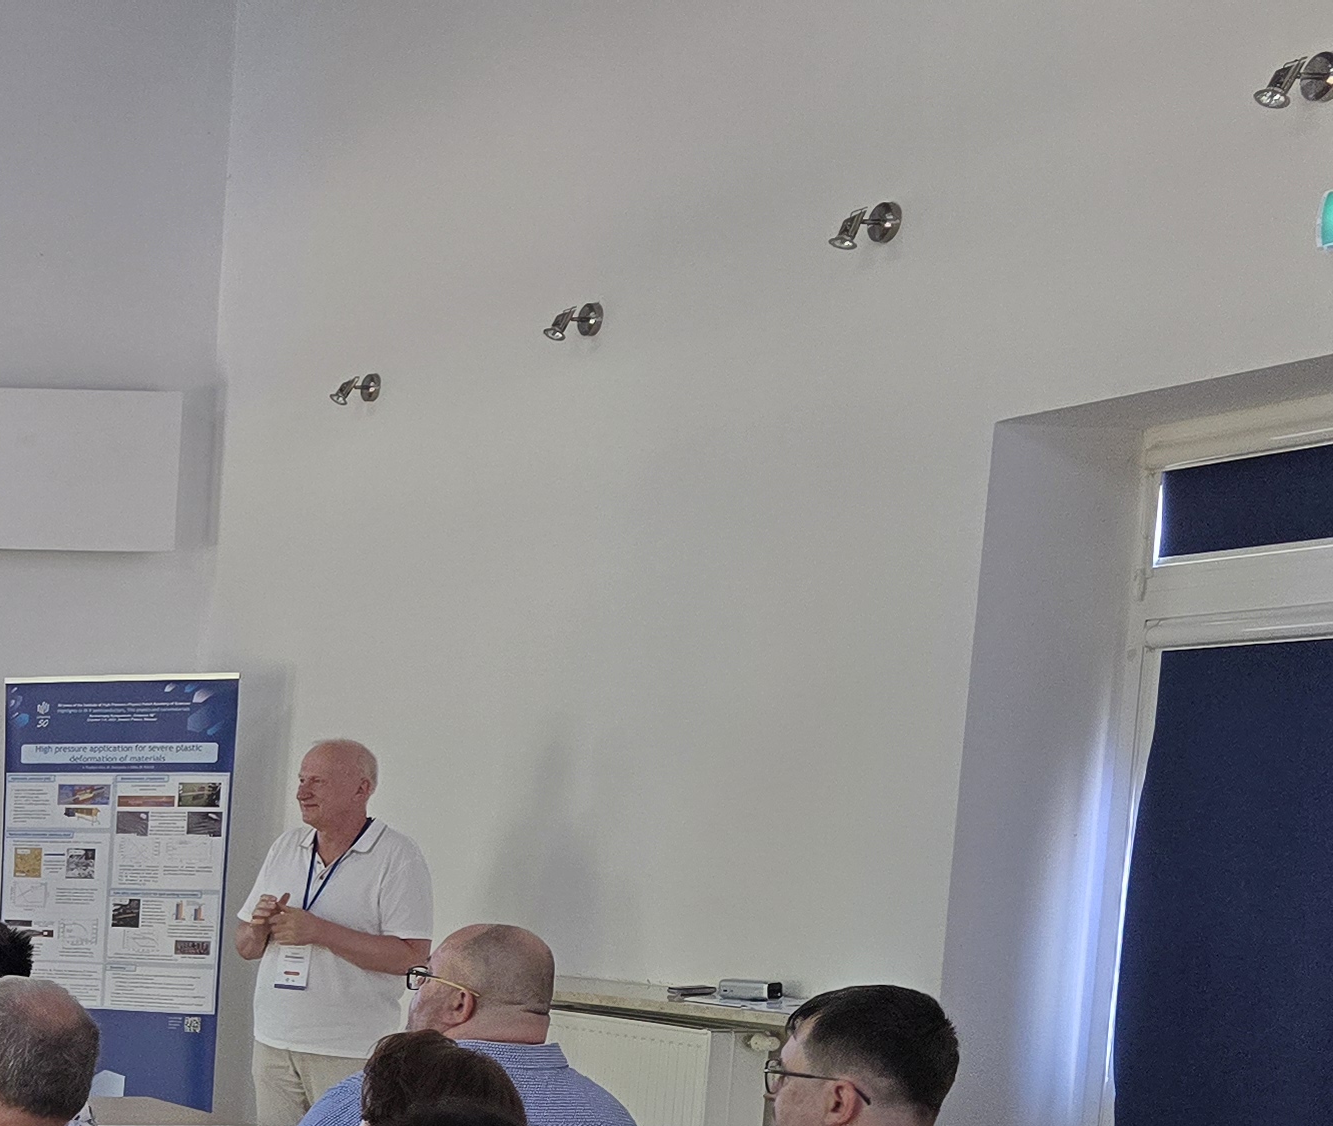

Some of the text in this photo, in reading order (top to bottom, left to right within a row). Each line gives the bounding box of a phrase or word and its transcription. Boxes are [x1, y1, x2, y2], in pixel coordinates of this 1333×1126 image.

[35, 745, 53, 755] High
[54, 746, 88, 755] pressure
[89, 745, 133, 754] application
[135, 744, 147, 752] for
[175, 744, 203, 753] plastic
[69, 755, 166, 763] deformation of materials
